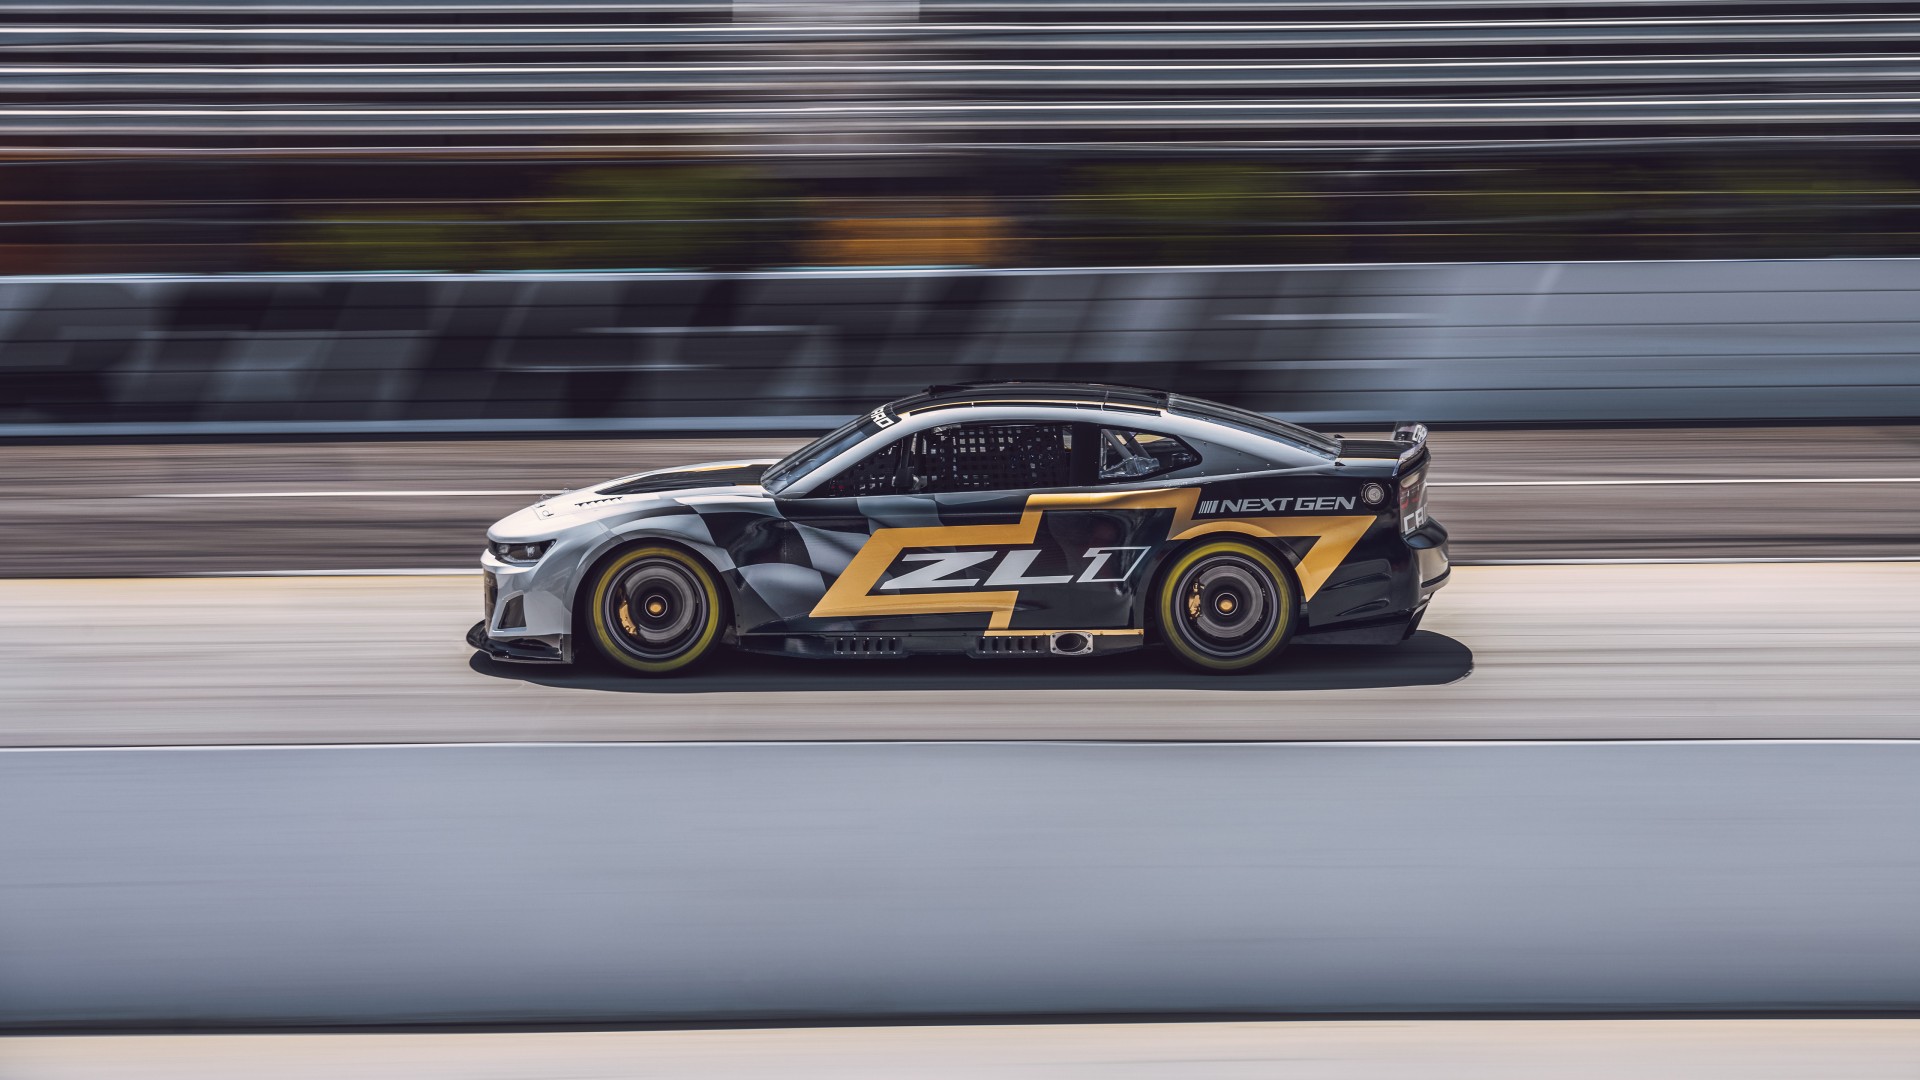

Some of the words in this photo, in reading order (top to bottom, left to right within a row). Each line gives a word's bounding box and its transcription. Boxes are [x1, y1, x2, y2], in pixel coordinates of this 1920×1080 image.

[1220, 498, 1293, 513] NEXT
[1294, 496, 1356, 511] GEN
[880, 545, 1152, 590] ZL1
